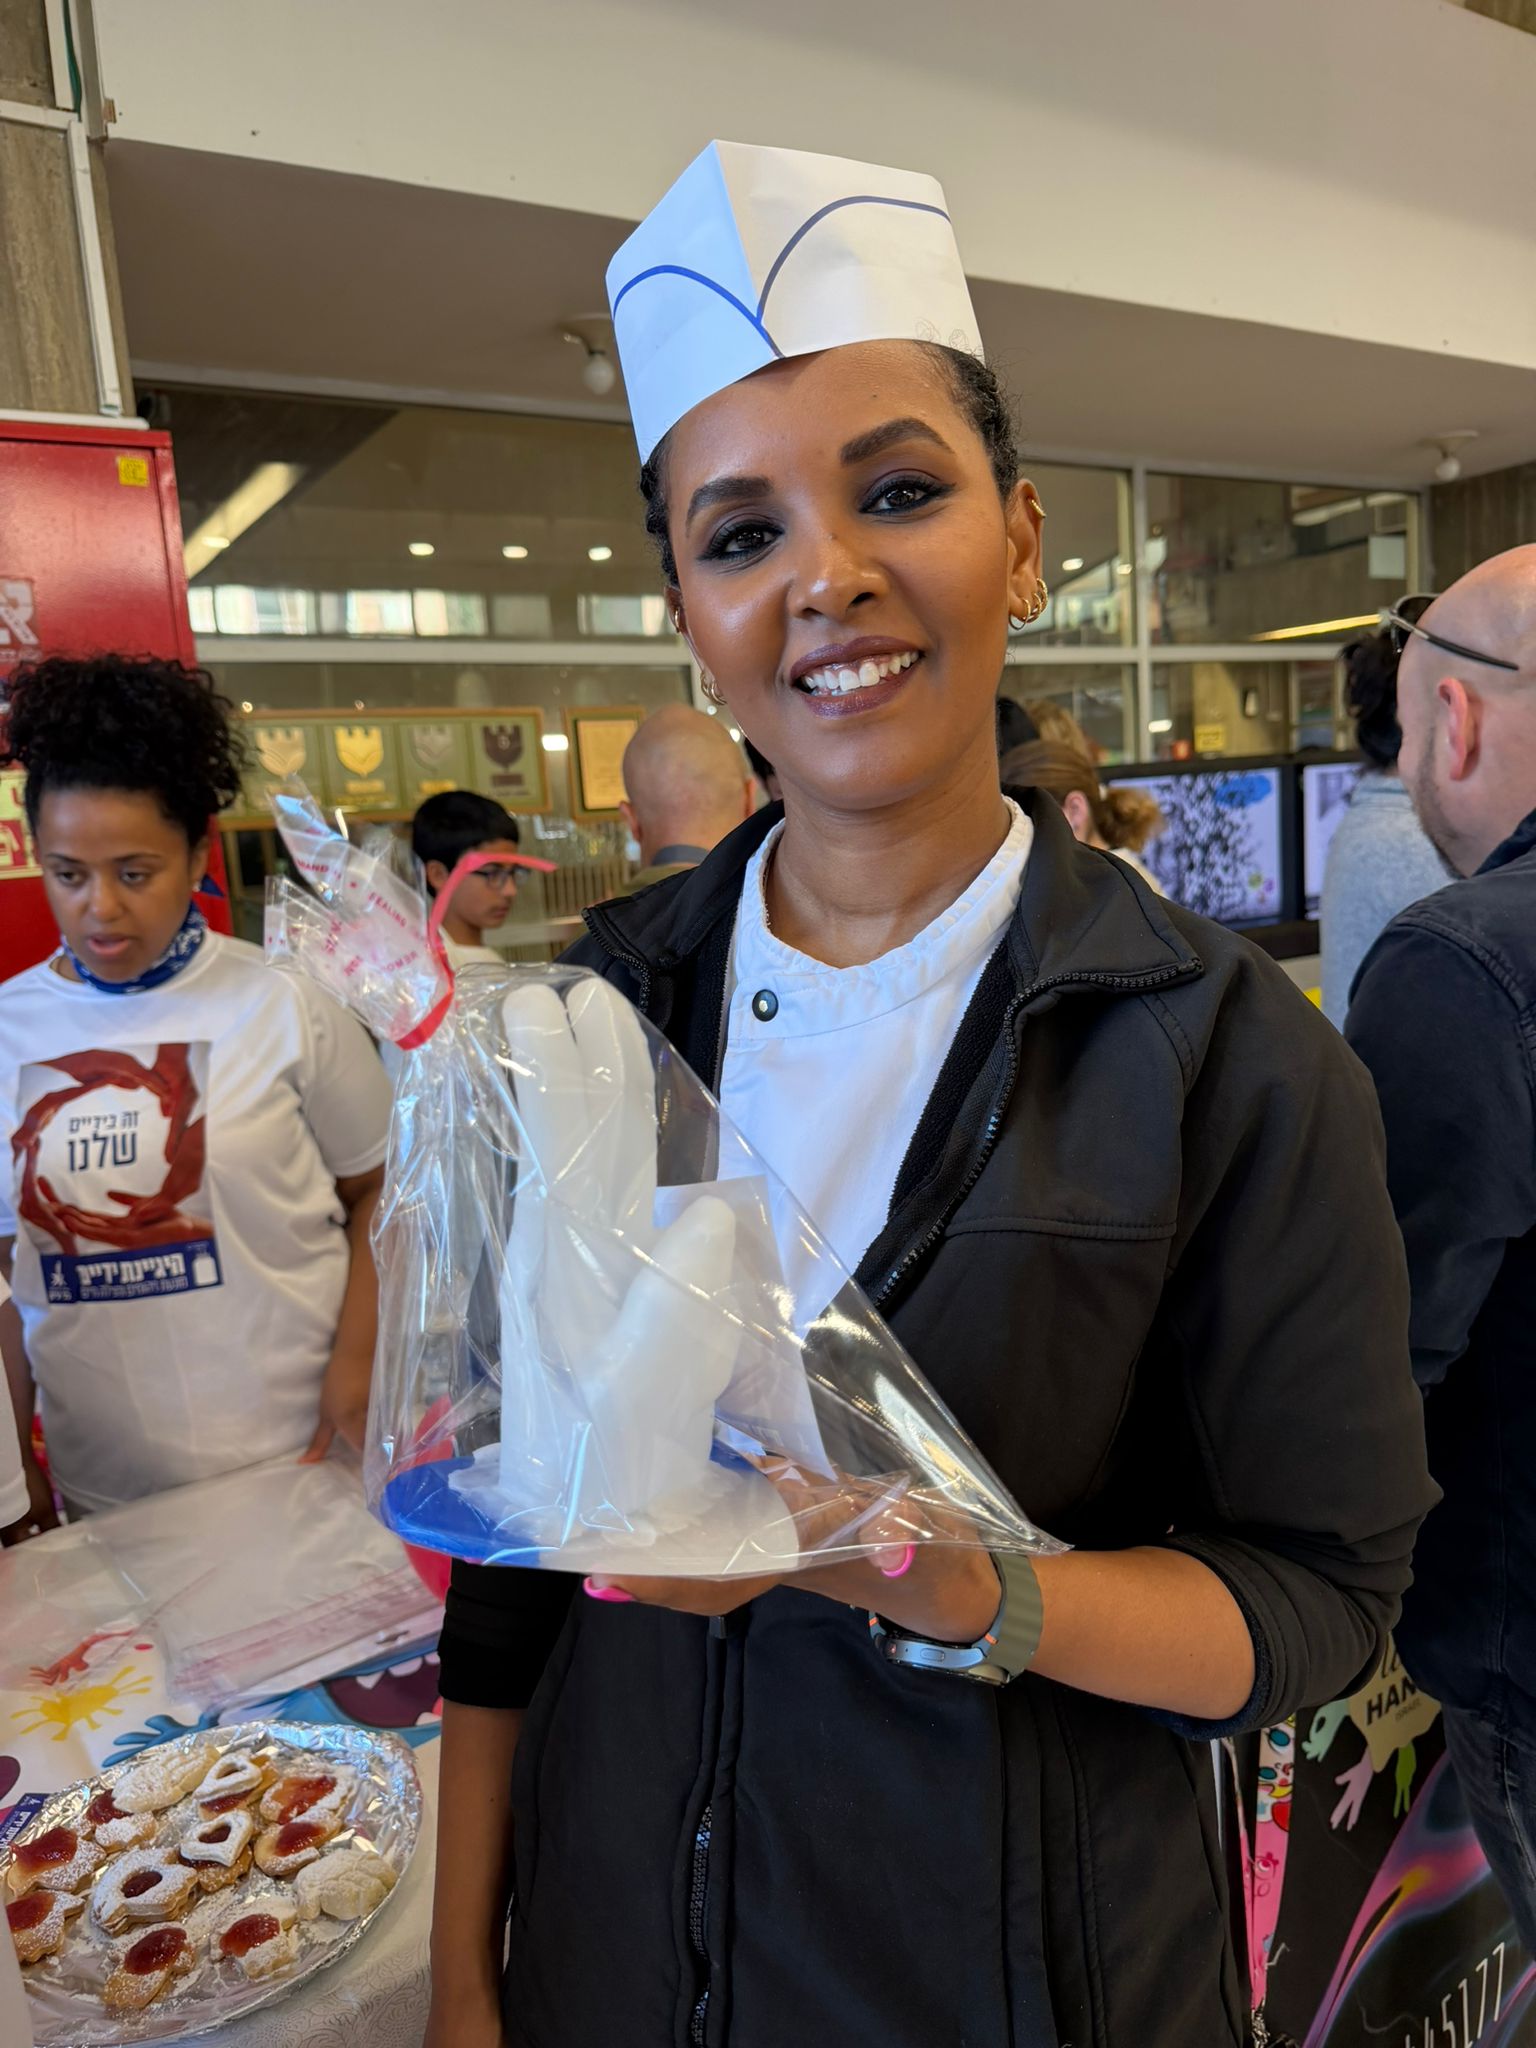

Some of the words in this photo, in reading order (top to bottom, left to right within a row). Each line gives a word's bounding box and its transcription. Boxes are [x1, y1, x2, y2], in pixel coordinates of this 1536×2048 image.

[122, 1110, 140, 1129] זה
[67, 1130, 138, 1173] שלנו
[76, 1261, 119, 1287] ידיים
